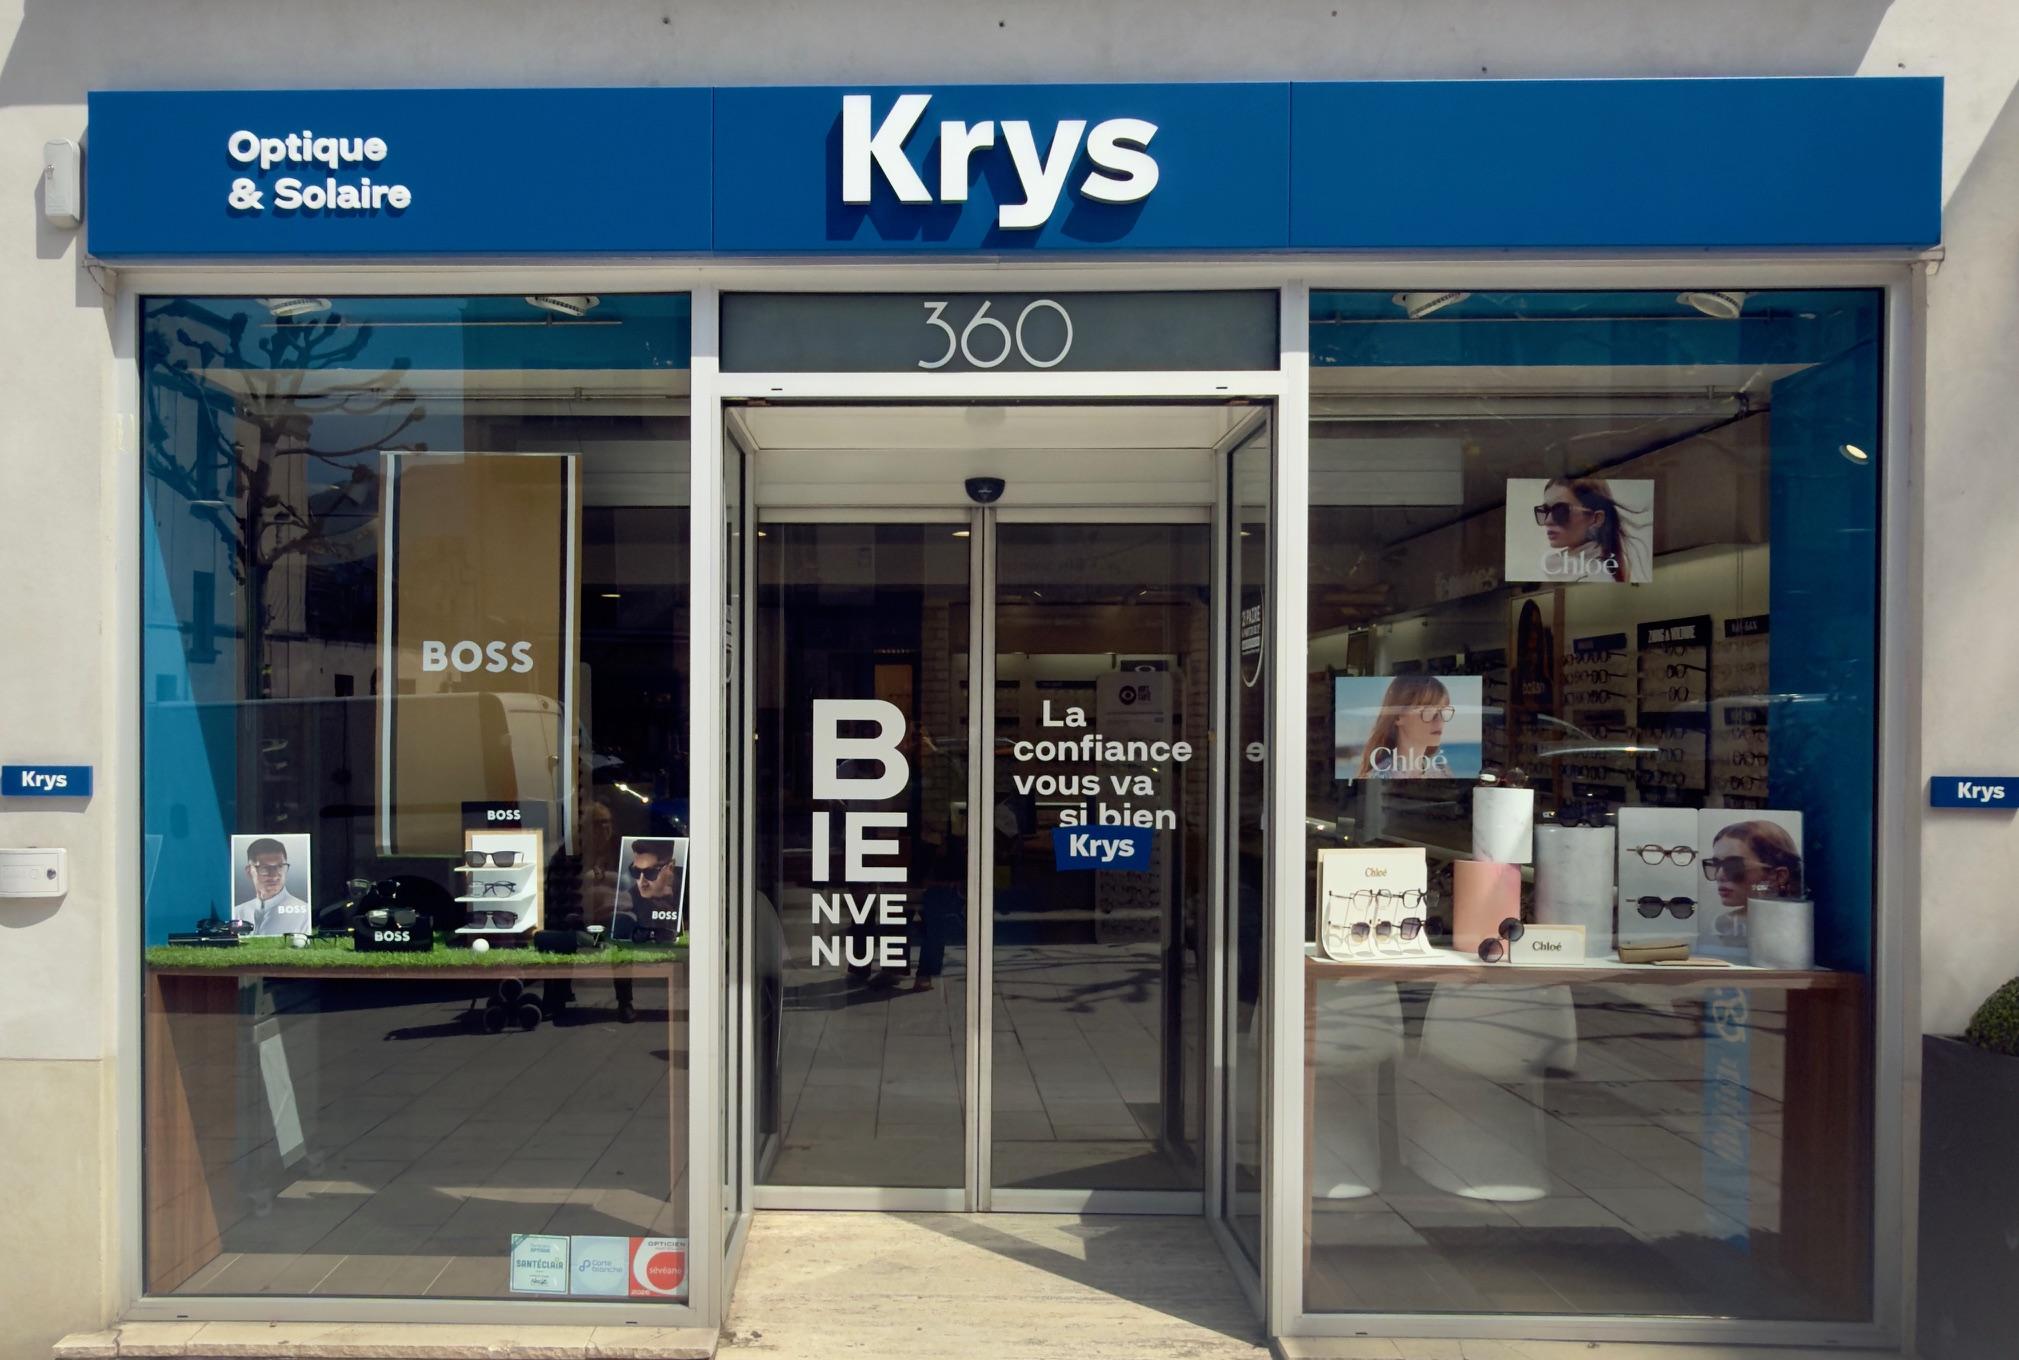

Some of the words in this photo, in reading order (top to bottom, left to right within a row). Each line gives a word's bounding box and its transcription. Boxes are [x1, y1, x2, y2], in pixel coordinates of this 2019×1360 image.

[227, 129, 388, 170] Optique
[842, 93, 1160, 230] Krys
[228, 178, 264, 211] &
[274, 177, 412, 211] Solaire
[917, 299, 1074, 369] 360
[1542, 549, 1619, 577] Chloé
[422, 640, 534, 674] BOSS
[1042, 700, 1087, 728] La
[812, 699, 910, 801] B
[1013, 734, 1193, 762] confiance
[1370, 746, 1448, 773] Chloé
[21, 770, 67, 791] Krys
[1013, 769, 1101, 796] vous
[1110, 769, 1154, 796] va
[1958, 782, 2005, 802] Krys
[487, 809, 521, 821] BOSS
[1059, 802, 1088, 829] si
[1098, 802, 1177, 830] bien
[811, 811, 908, 882] IE
[1069, 833, 1136, 863] Krys
[1364, 866, 1388, 878] Chloé
[277, 904, 307, 915] BOSS
[651, 909, 678, 921] BOSS
[811, 893, 908, 925] NVE
[374, 930, 411, 943] BOSS
[1531, 940, 1563, 953] Chloé
[811, 935, 908, 967] NUE
[648, 1240, 686, 1248] OPTICIEN
